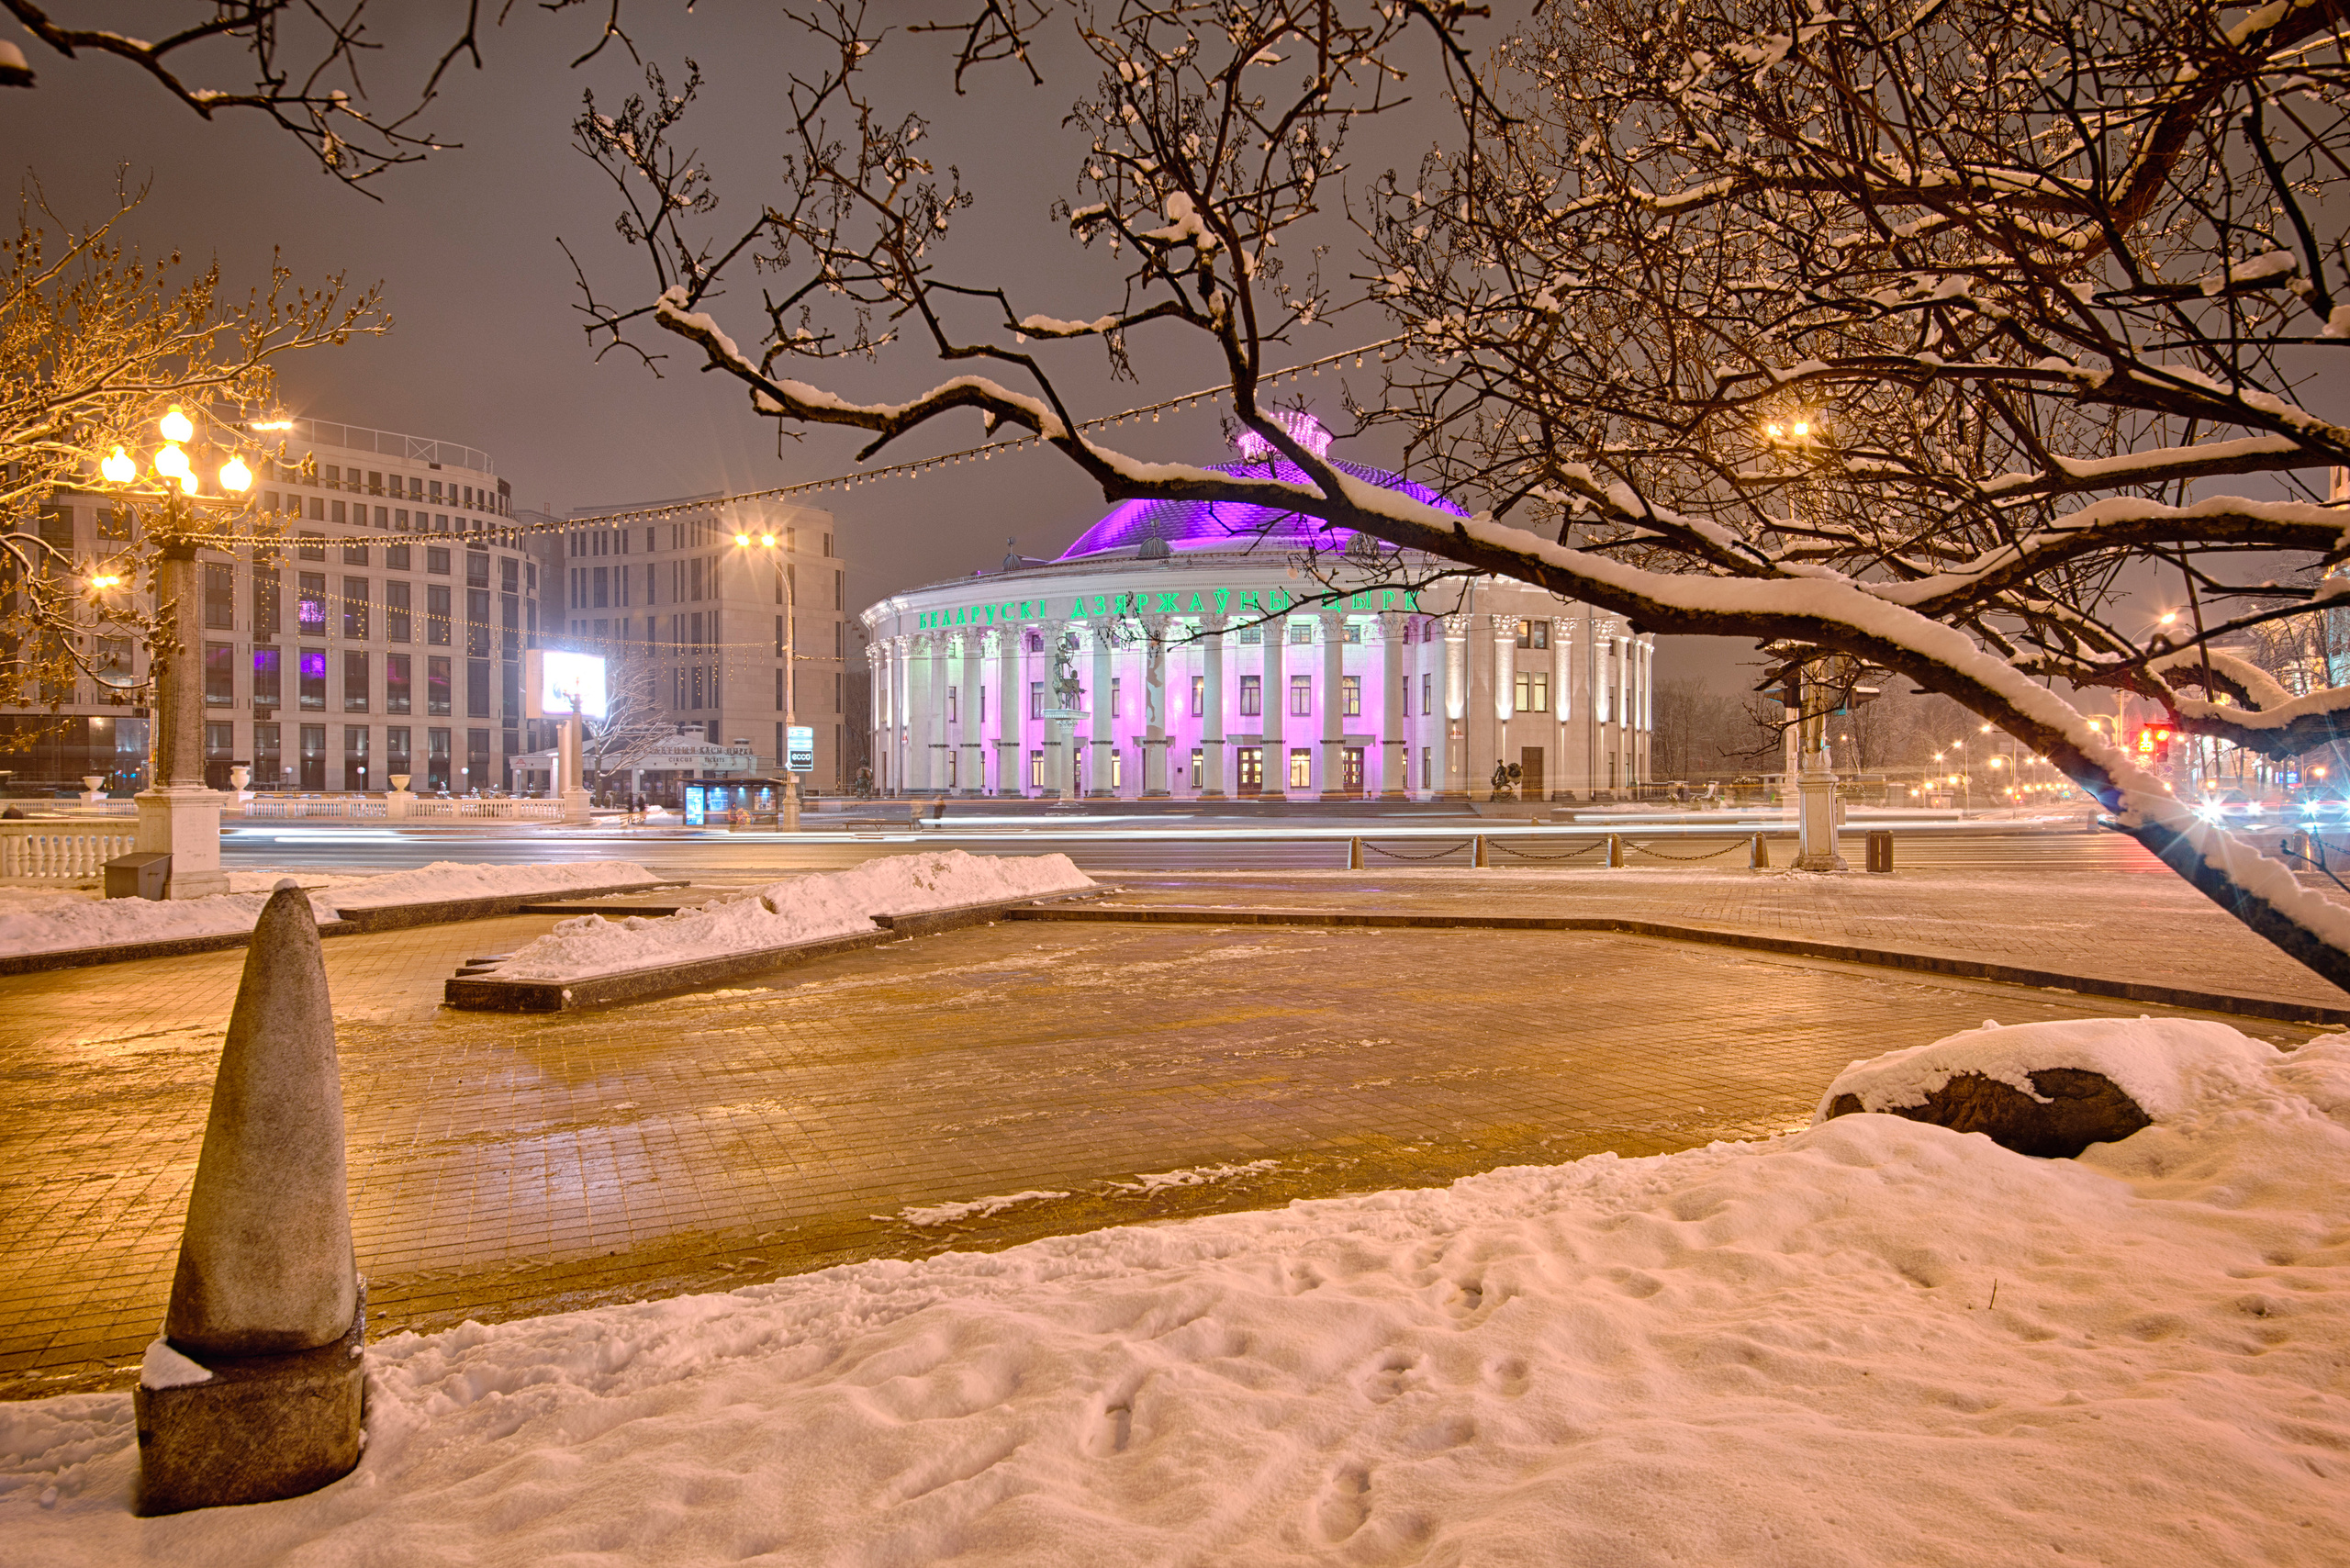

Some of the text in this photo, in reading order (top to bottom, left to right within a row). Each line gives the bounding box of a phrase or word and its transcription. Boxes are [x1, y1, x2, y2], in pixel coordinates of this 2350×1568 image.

[920, 588, 1421, 630] БЕЛАРУСКІ ДЗЯРЖАЎНЫ ЦЫРК
[791, 753, 811, 761] ecco
